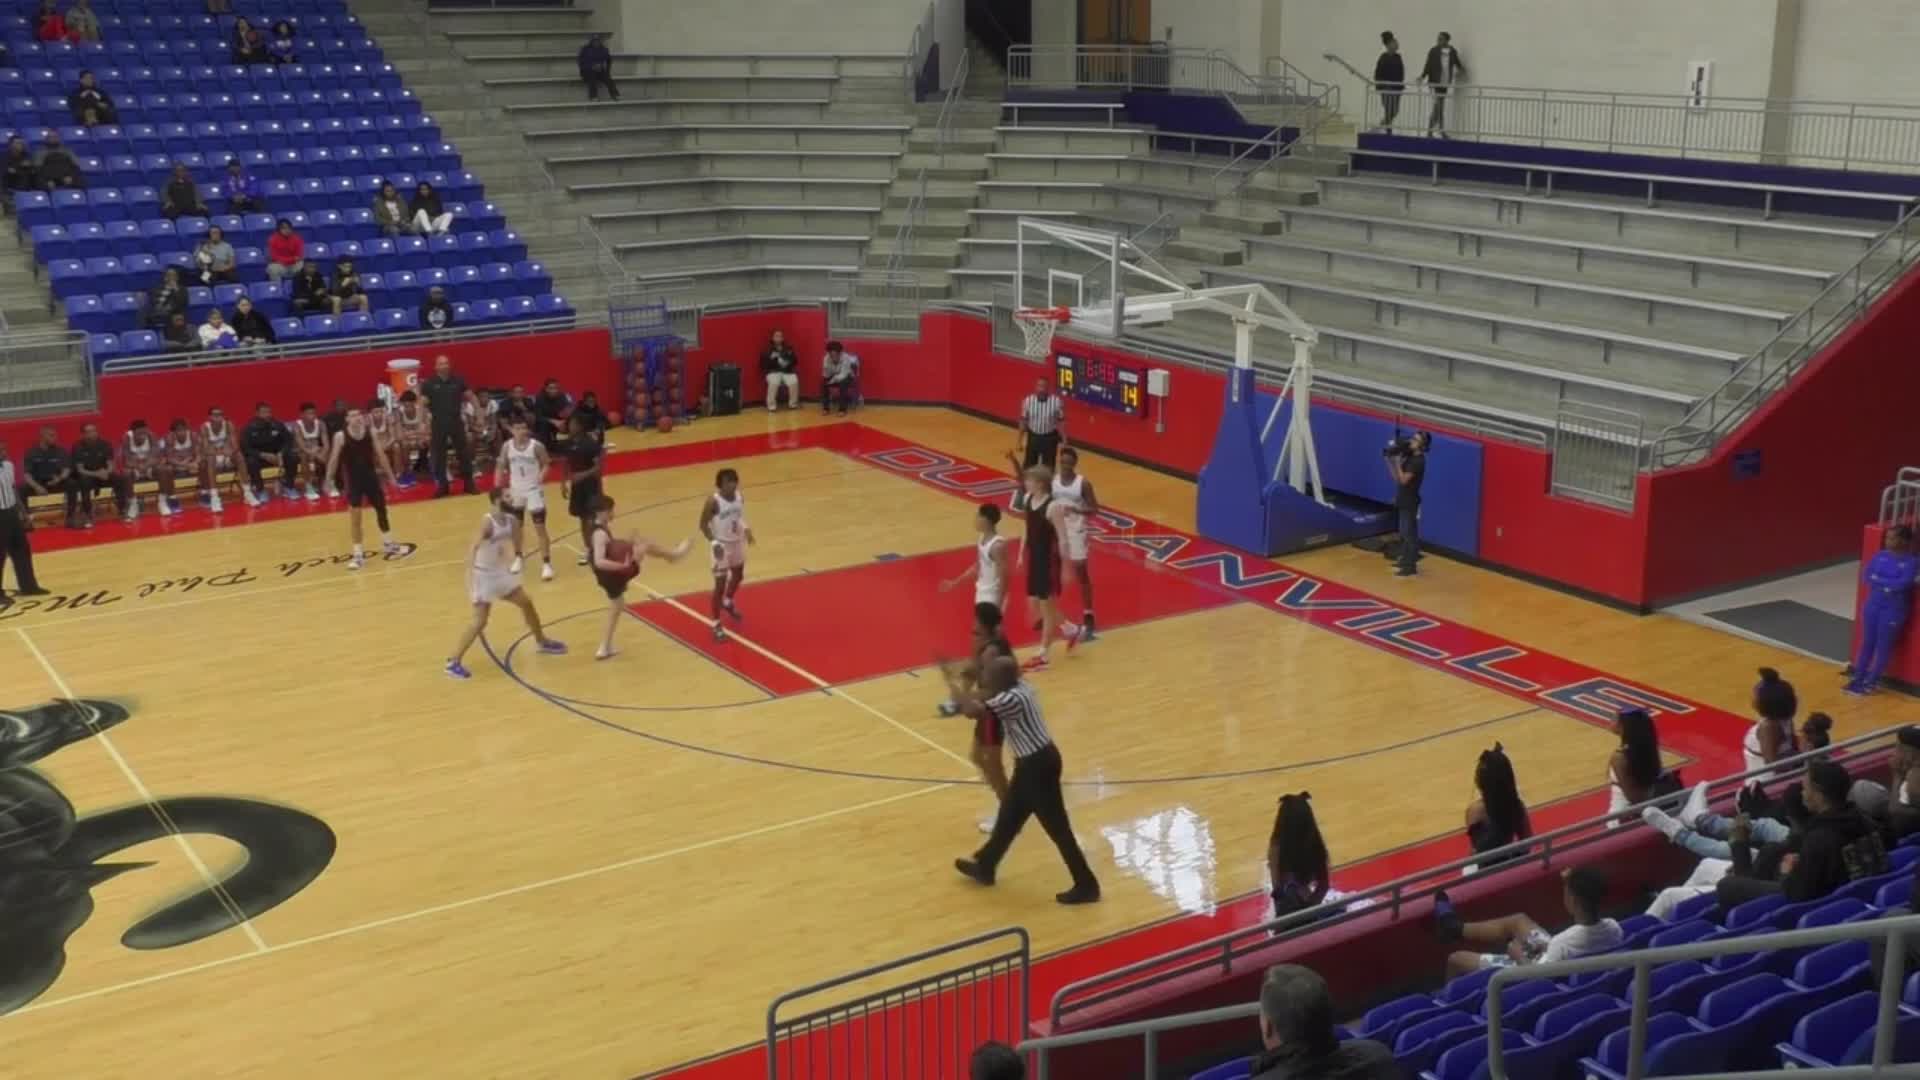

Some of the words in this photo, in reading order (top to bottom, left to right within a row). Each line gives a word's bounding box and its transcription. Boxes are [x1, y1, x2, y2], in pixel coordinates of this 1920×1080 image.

[1059, 367, 1073, 389] 19
[1123, 383, 1137, 408] 14
[136, 567, 257, 598] Phil
[866, 446, 1697, 723] DUCANVILLE
